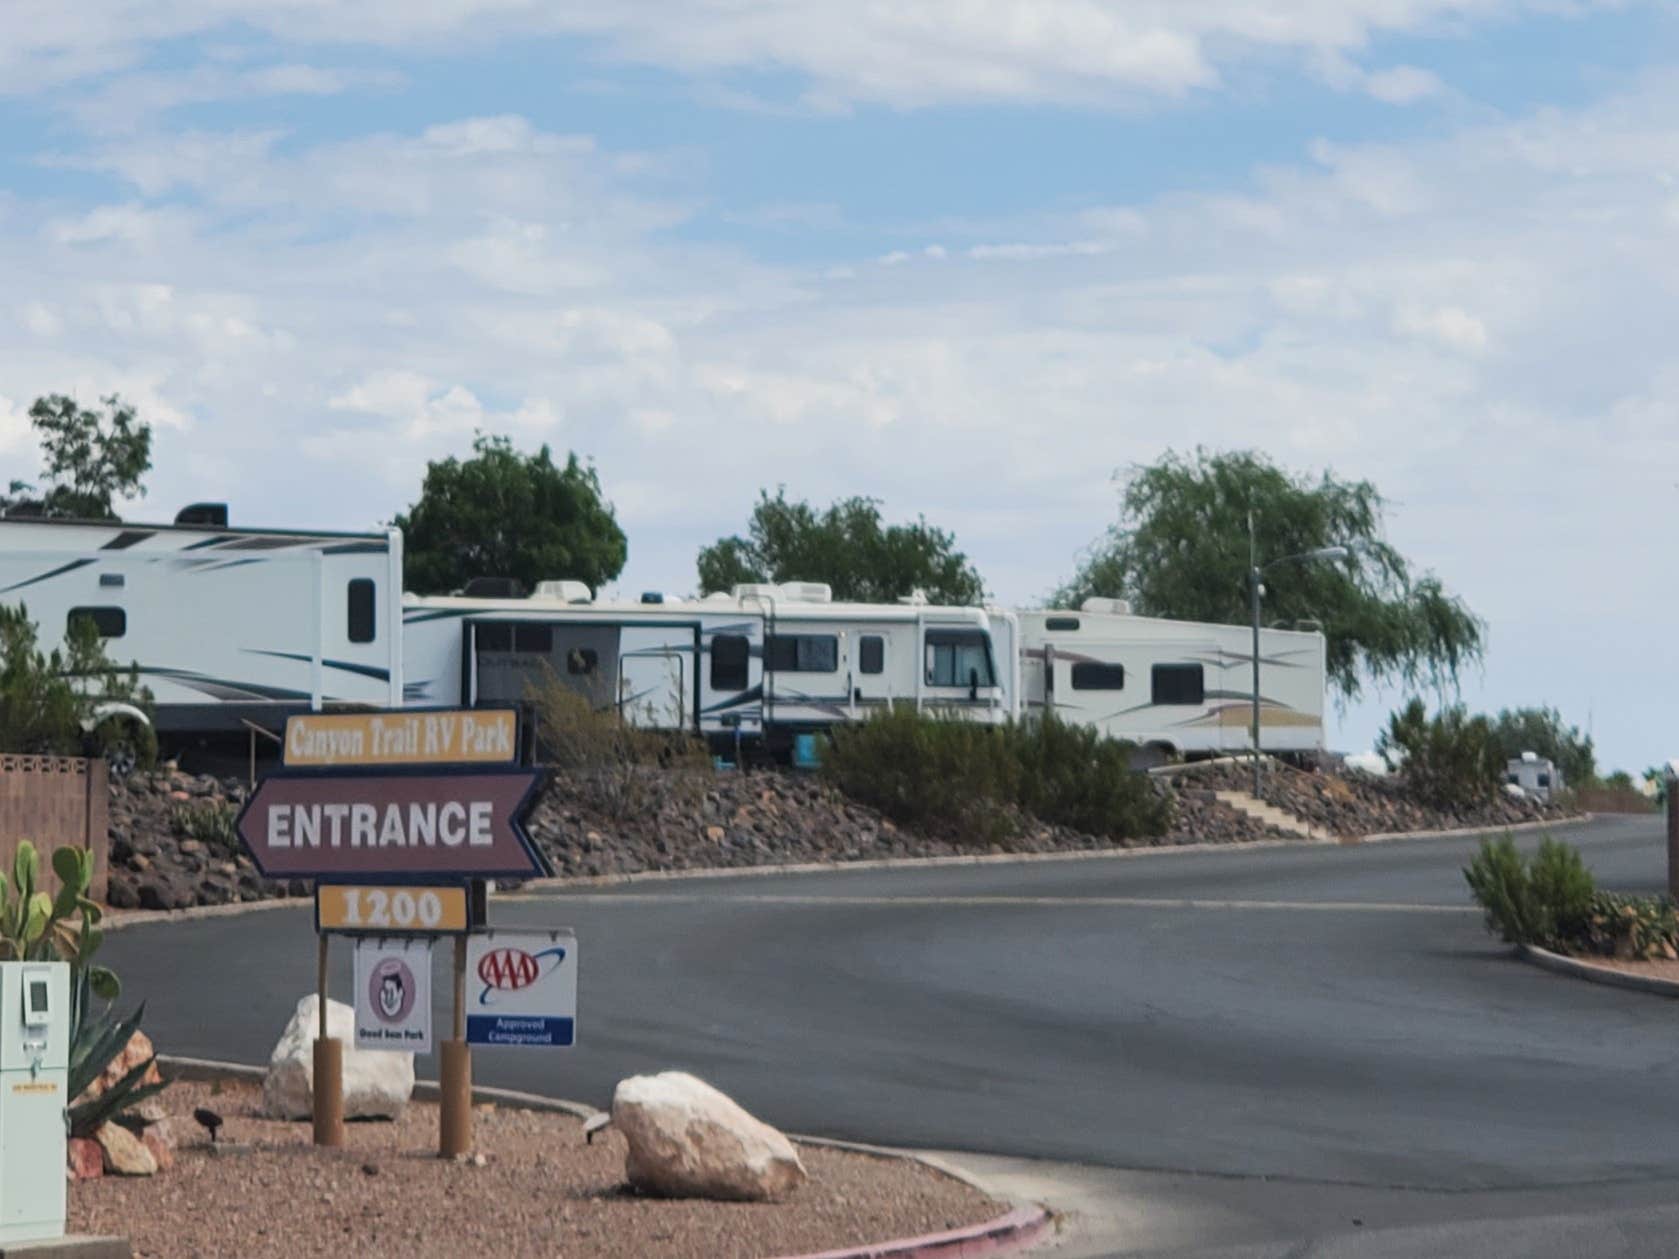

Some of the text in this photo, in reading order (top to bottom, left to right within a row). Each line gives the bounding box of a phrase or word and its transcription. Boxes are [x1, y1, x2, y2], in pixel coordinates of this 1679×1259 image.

[290, 715, 510, 763] Canyon Trail RV Park
[267, 801, 493, 847] ENTRANCE
[343, 890, 442, 927] 1200
[479, 949, 537, 991] AAA
[404, 1029, 424, 1039] Park
[488, 1031, 552, 1044] Campground
[496, 1018, 545, 1031] Approved
